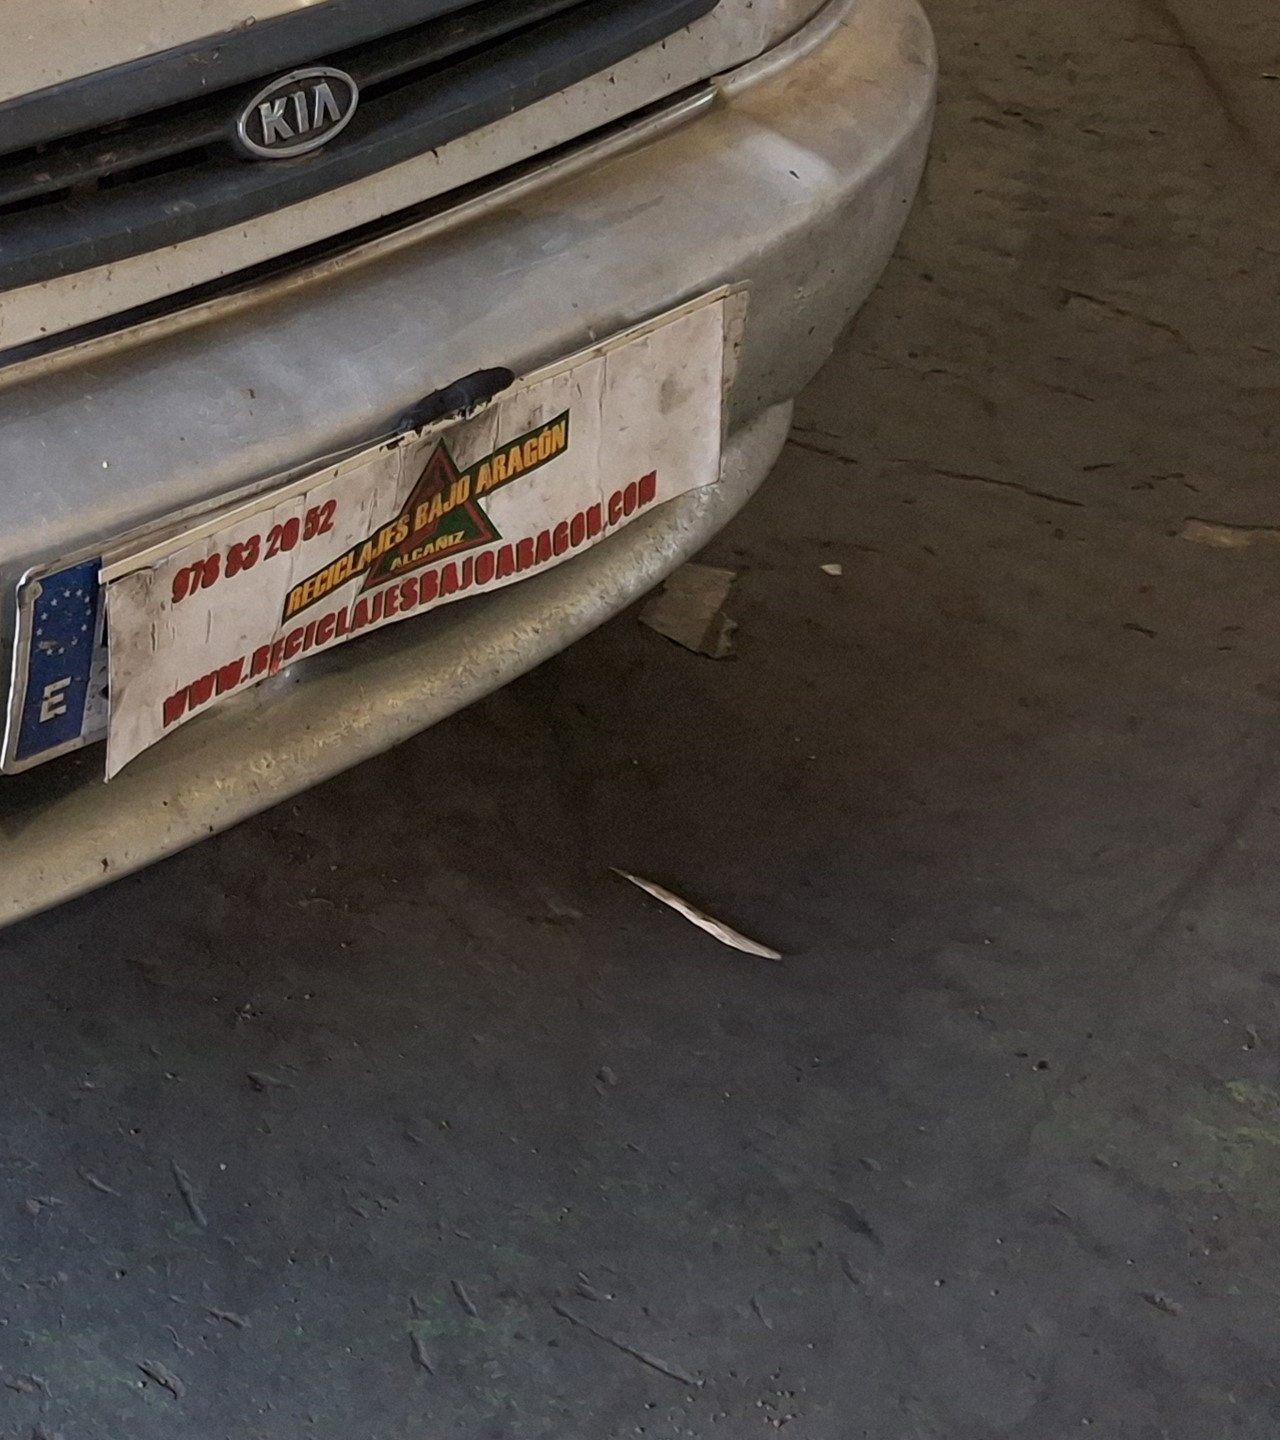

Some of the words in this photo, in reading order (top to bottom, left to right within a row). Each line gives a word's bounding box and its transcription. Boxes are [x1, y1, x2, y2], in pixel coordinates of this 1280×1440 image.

[258, 81, 341, 145] KIA
[264, 517, 301, 562] 20
[302, 499, 337, 542] 52
[287, 514, 410, 615] RECICLAJES
[414, 474, 471, 532] BAJO
[475, 419, 567, 495] ARAGÓN
[390, 530, 466, 571] ALCAÑIZ
[162, 469, 658, 729] WWW.RECICLAJESBAJOARAGON.COM
[39, 675, 72, 723] E
